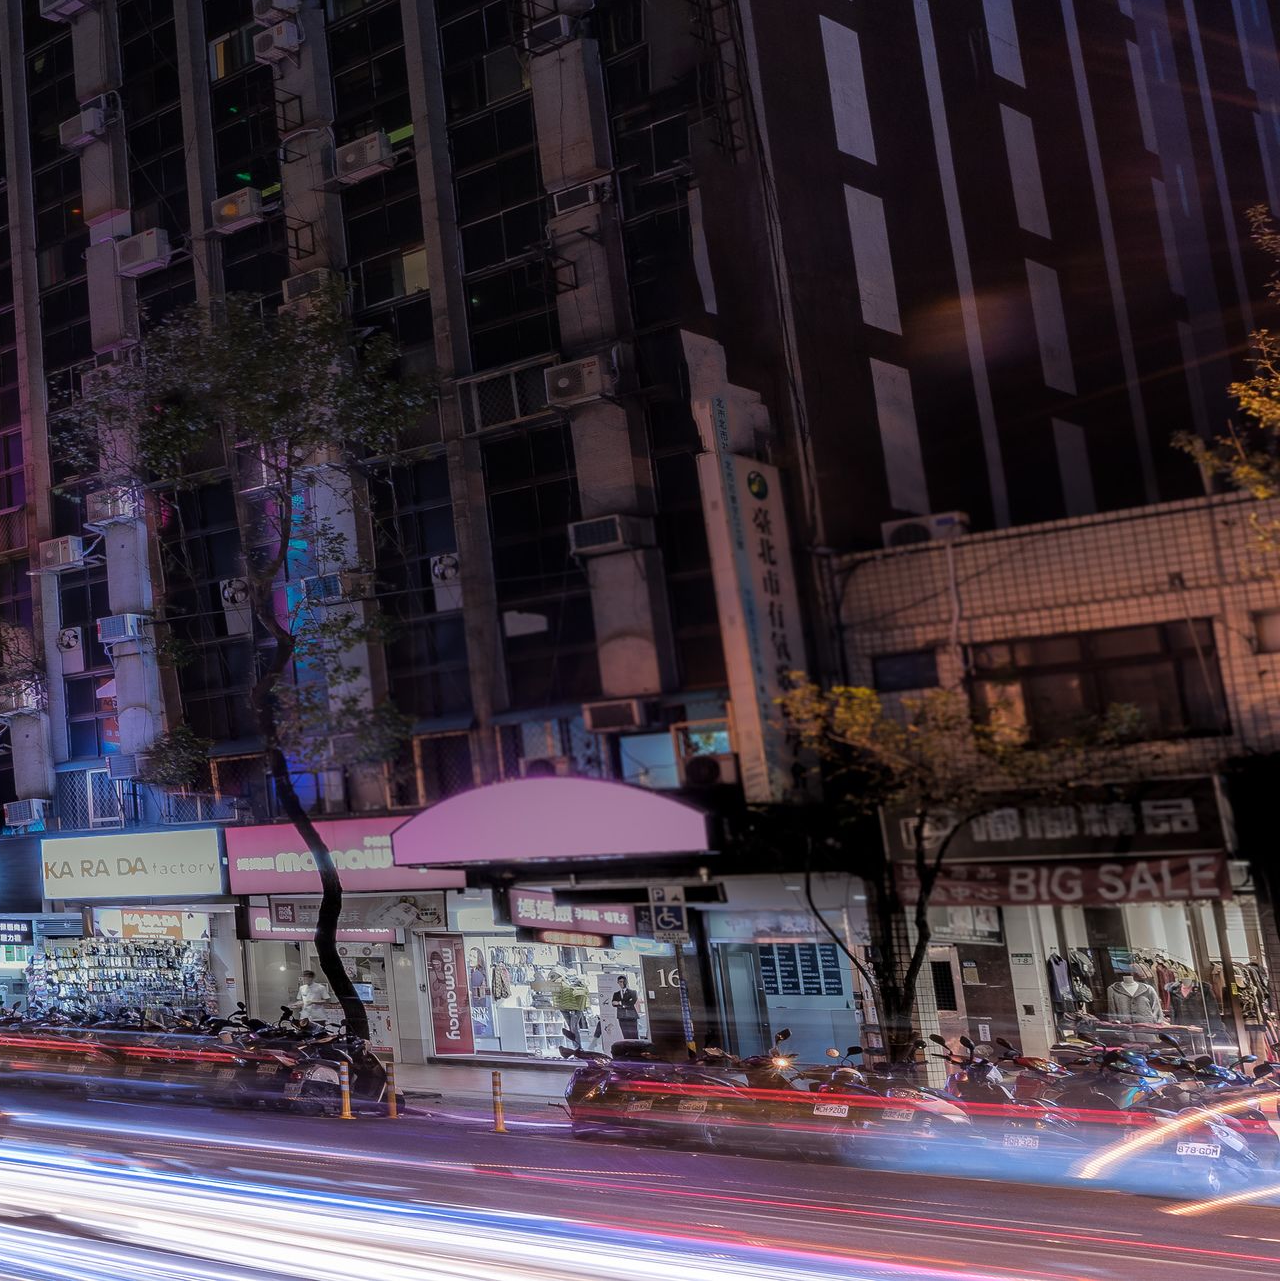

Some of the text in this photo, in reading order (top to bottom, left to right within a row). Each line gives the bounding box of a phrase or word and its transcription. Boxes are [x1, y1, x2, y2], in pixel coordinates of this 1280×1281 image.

[45, 857, 216, 879] KA RA DA factory
[1008, 856, 1221, 902] BIG SALE
[442, 948, 461, 1040] mamaway
[1178, 1145, 1218, 1156] 878-GDM
